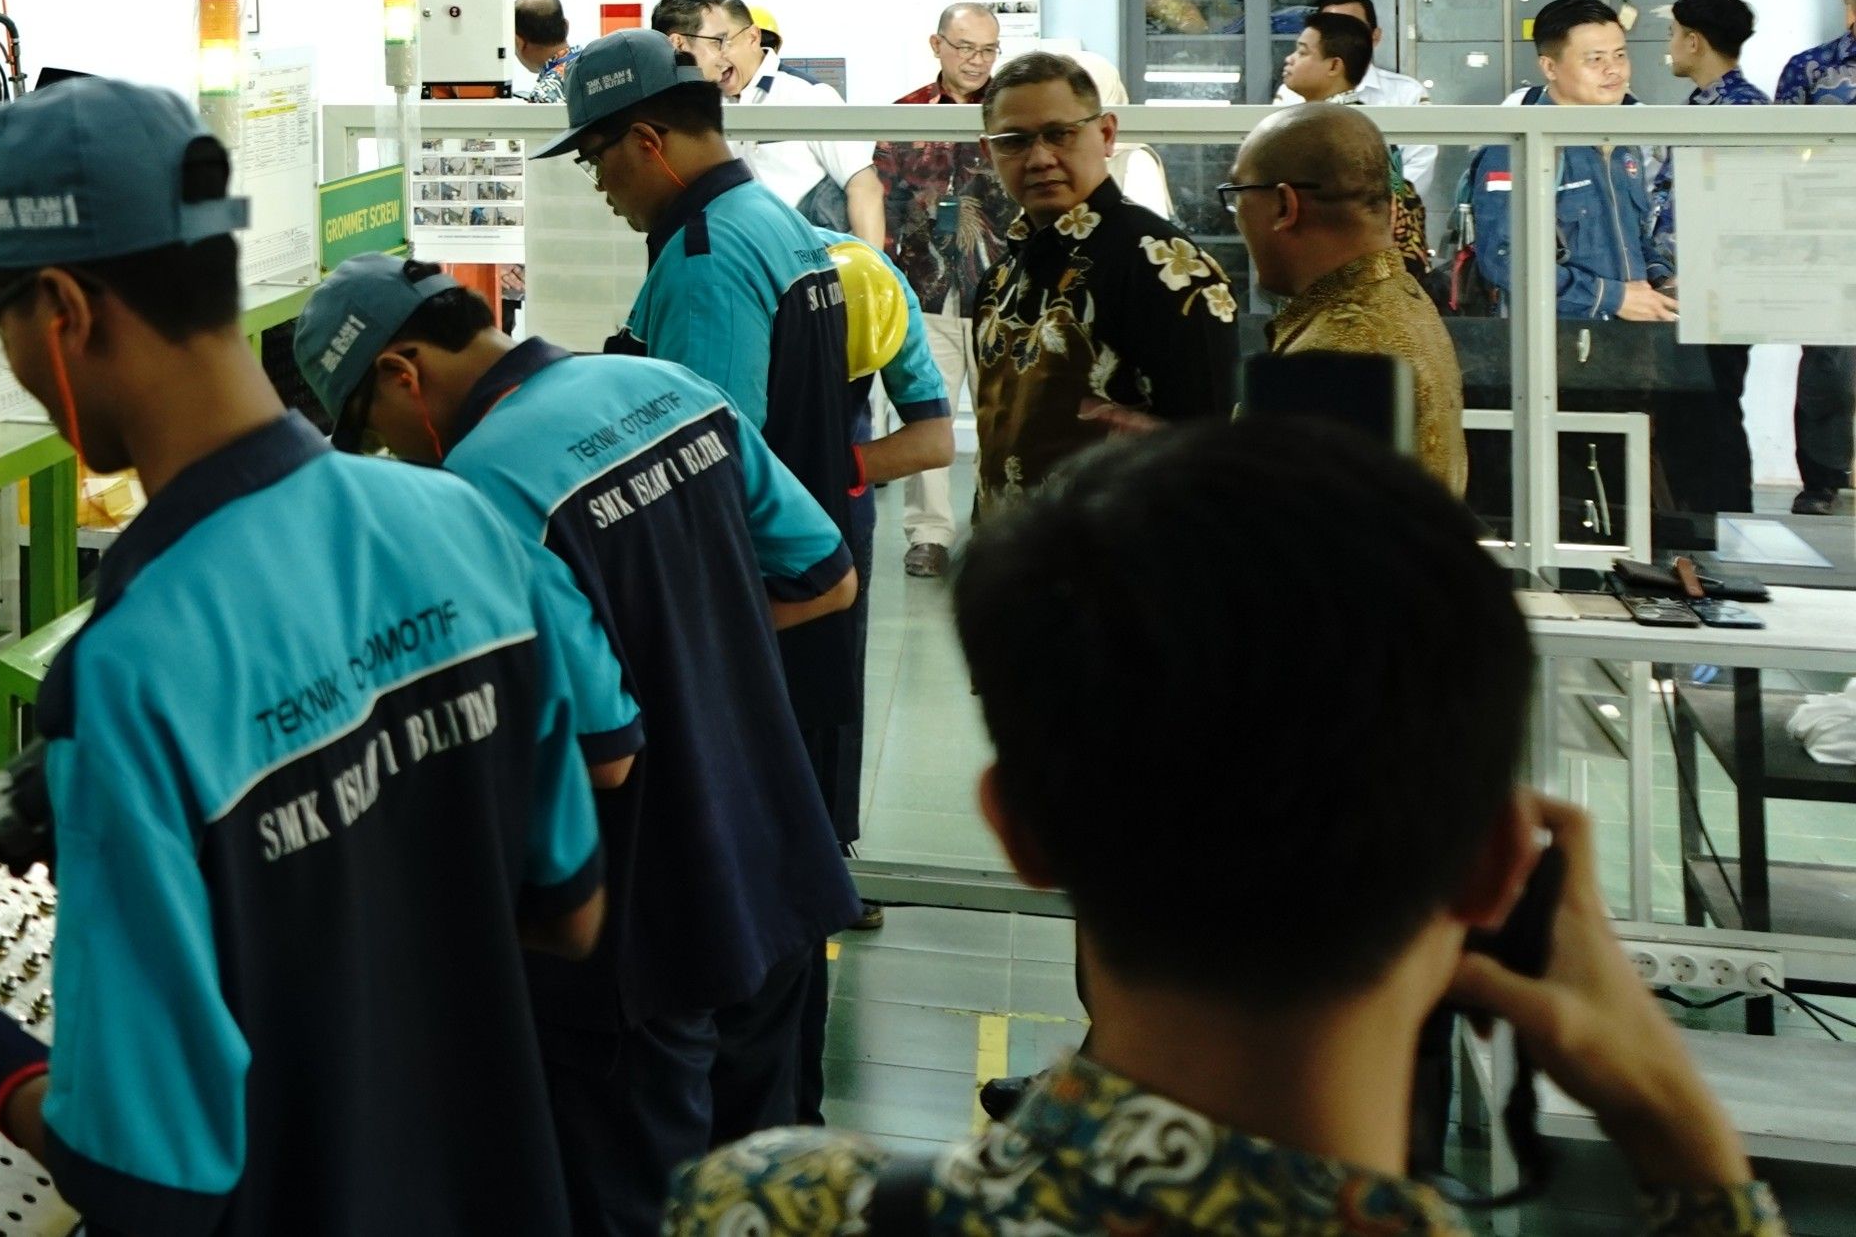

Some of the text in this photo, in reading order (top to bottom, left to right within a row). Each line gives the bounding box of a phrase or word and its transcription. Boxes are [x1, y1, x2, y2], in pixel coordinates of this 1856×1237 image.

[325, 199, 400, 244] GROMMET SCREW
[567, 391, 682, 463] TEKNIK OTOMOTIF
[588, 486, 635, 529] SMK
[257, 789, 331, 862] SMK
